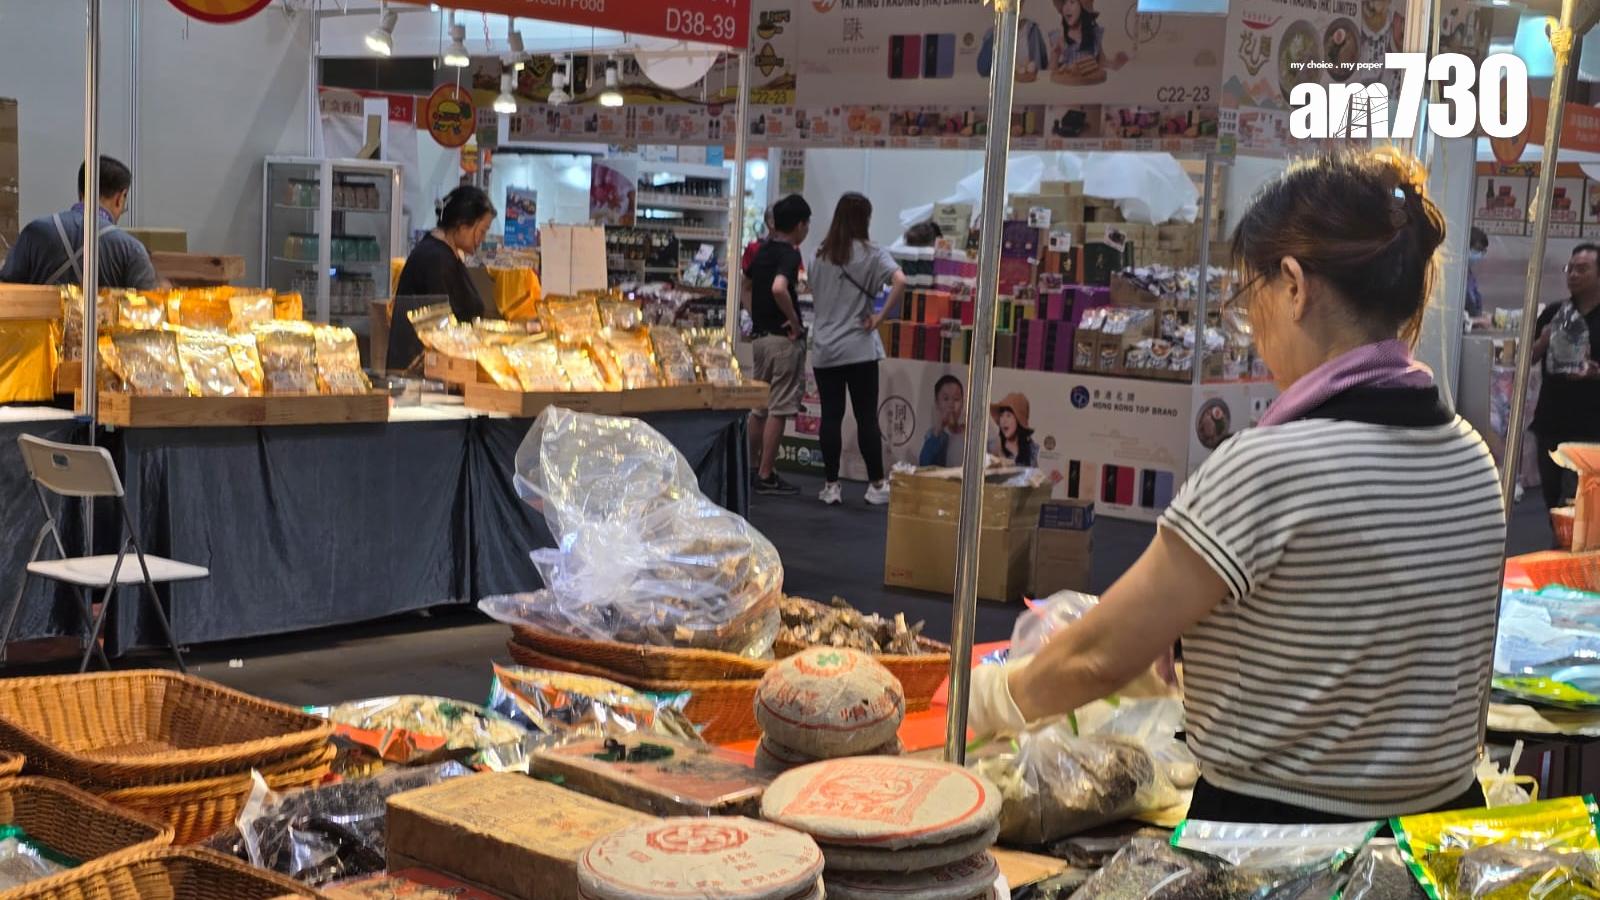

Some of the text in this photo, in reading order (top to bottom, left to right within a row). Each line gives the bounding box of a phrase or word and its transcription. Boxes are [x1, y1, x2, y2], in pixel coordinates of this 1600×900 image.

[666, 7, 736, 40] D38-39
[1157, 86, 1210, 103] C22-23
[1093, 402, 1178, 417] HONG KONG TOP BRAND
